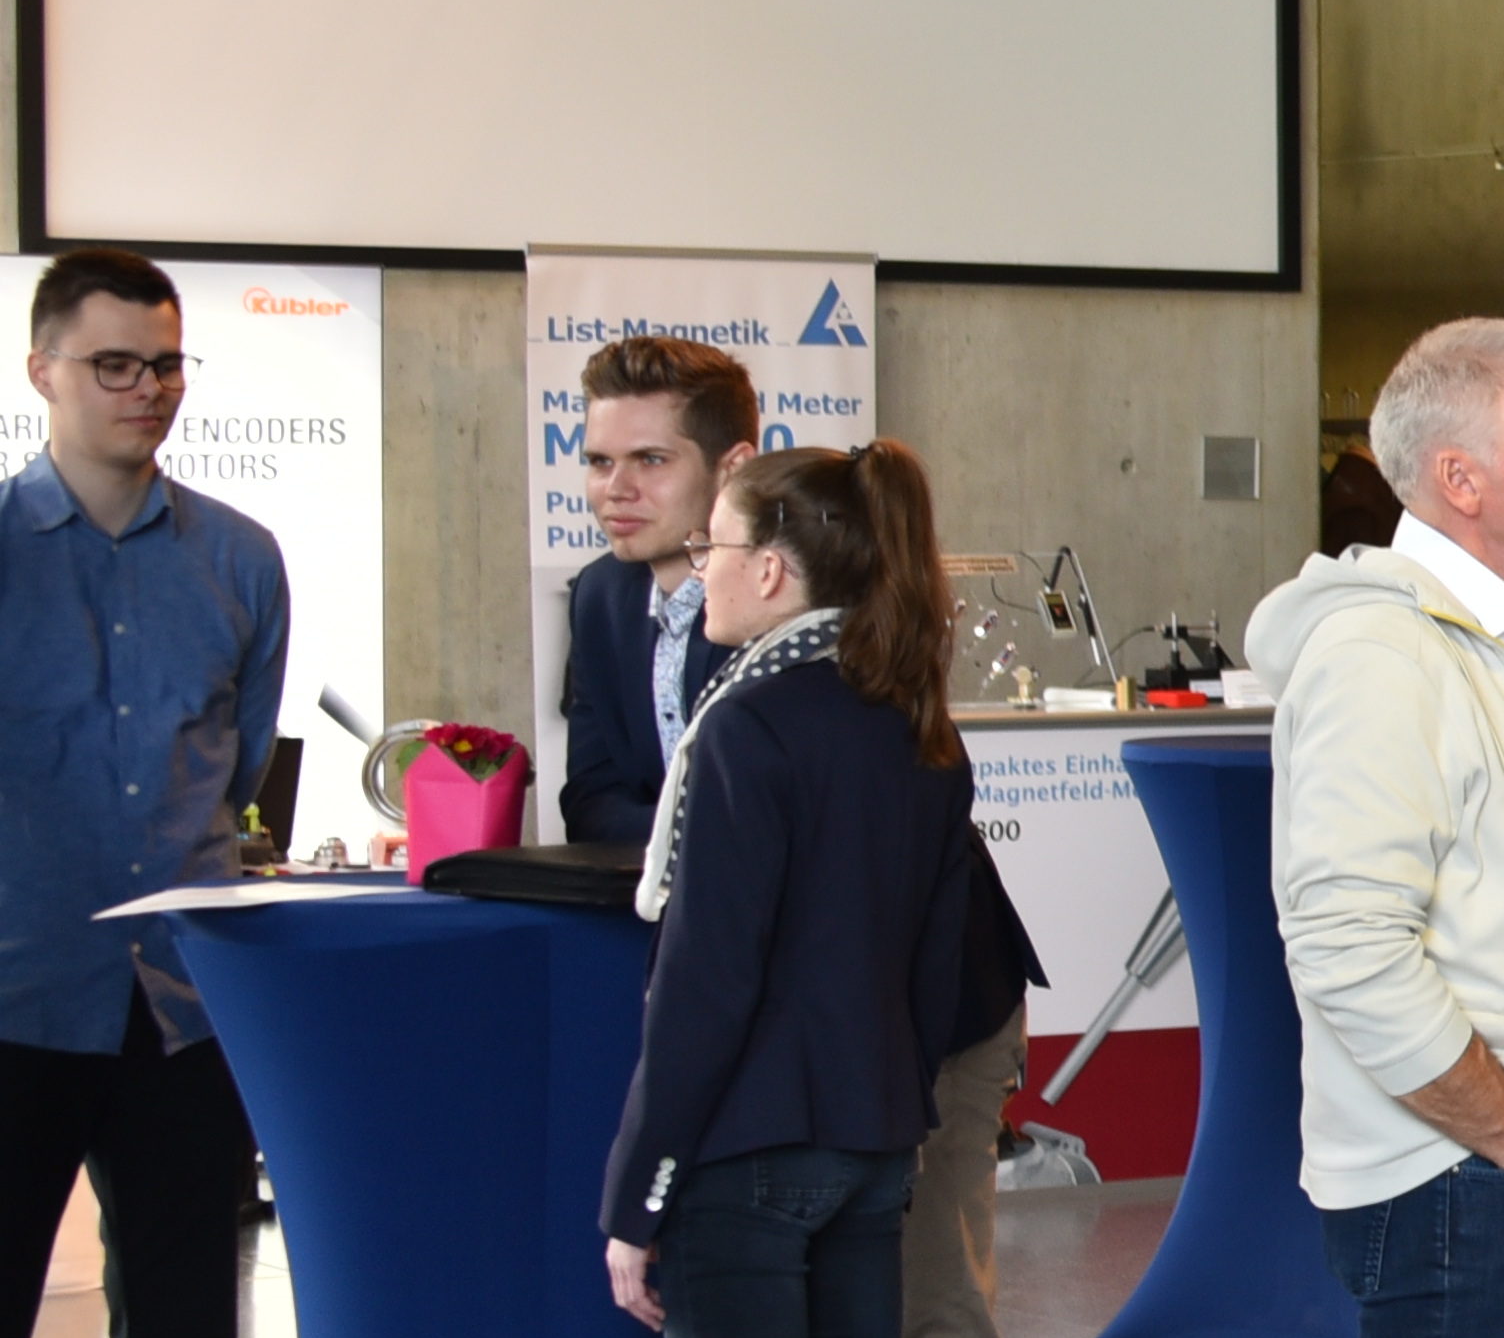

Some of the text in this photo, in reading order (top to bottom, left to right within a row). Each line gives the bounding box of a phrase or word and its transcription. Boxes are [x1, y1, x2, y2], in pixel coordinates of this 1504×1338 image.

[777, 393, 863, 416] Meter
[183, 417, 347, 445] ENCODERS
[972, 754, 1128, 780] paktes Einha
